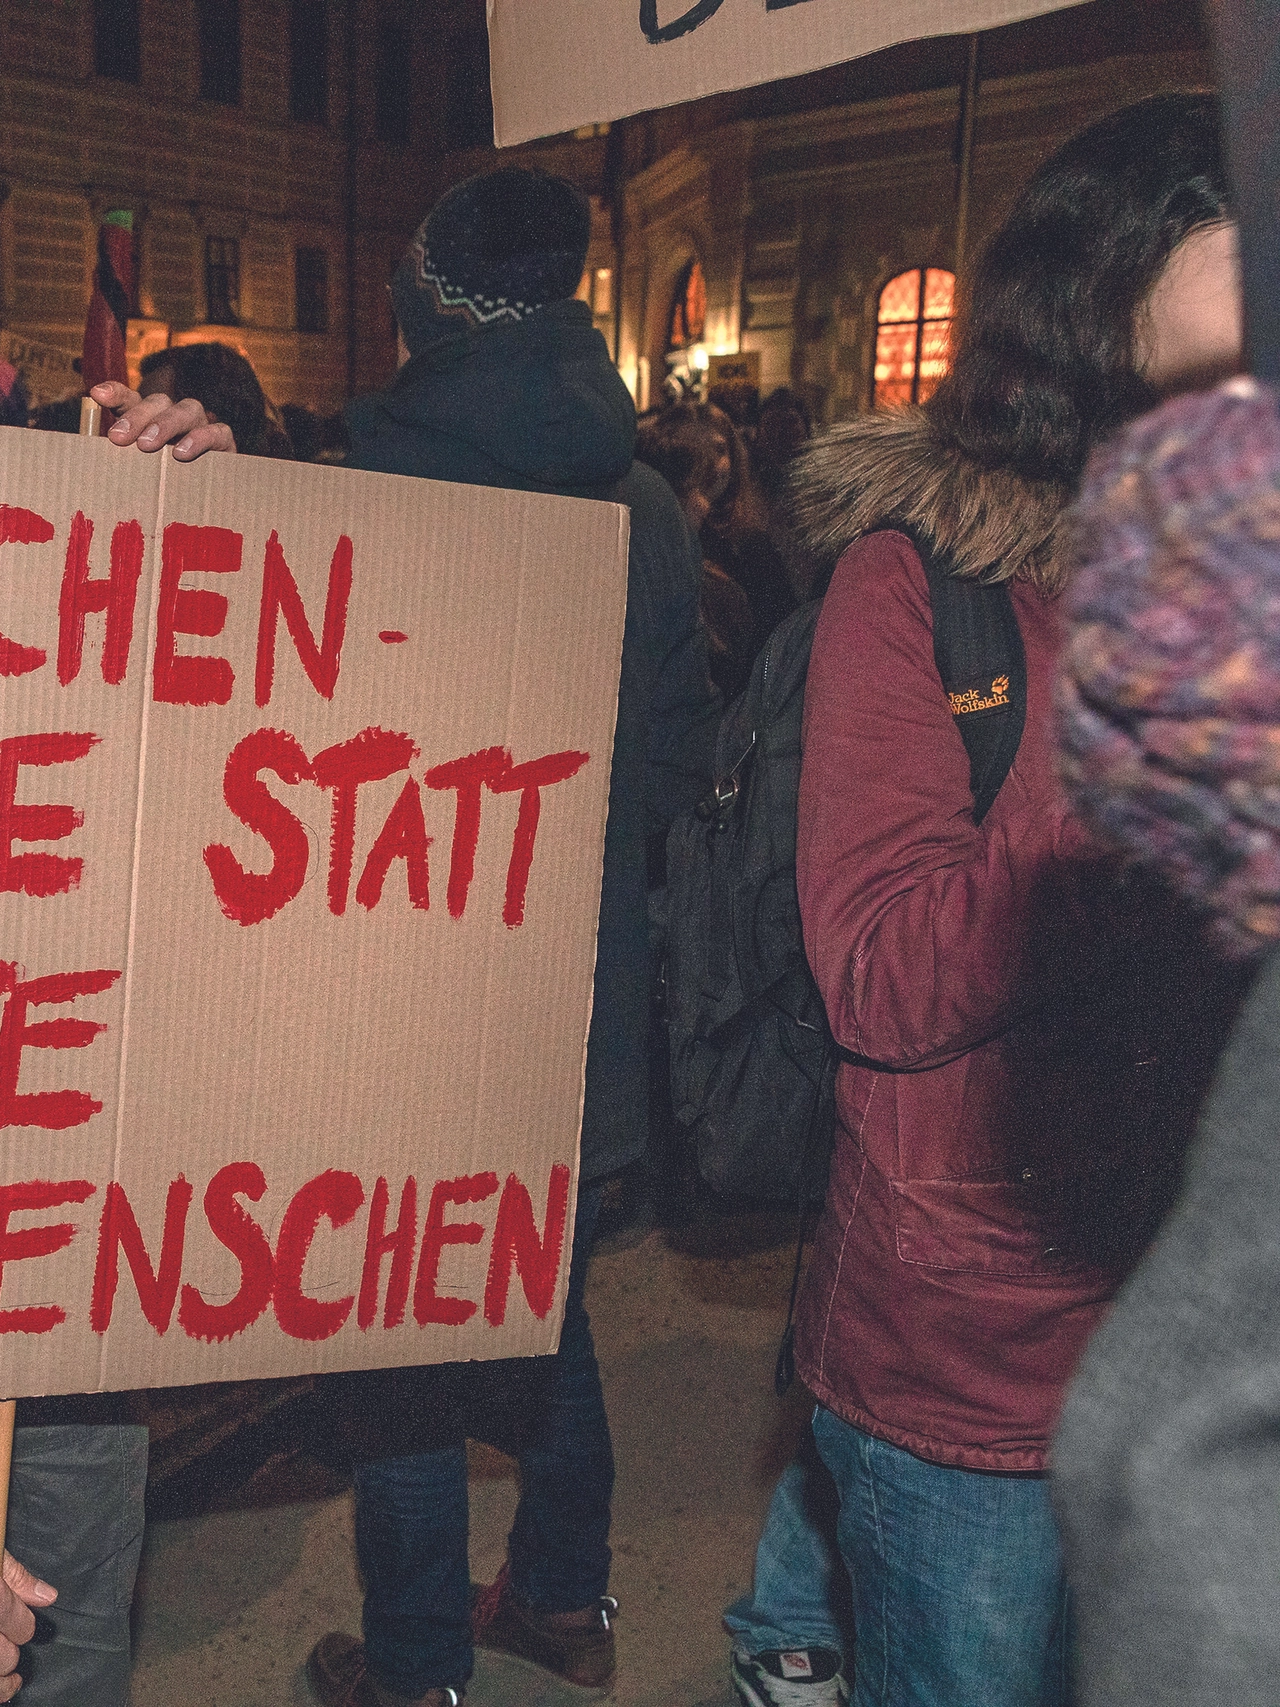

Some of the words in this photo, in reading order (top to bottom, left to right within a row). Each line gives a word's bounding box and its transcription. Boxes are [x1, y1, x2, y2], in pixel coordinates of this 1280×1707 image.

[948, 689, 980, 704] Jack
[950, 693, 1010, 715] Wolfskin
[202, 726, 590, 930] STATT
